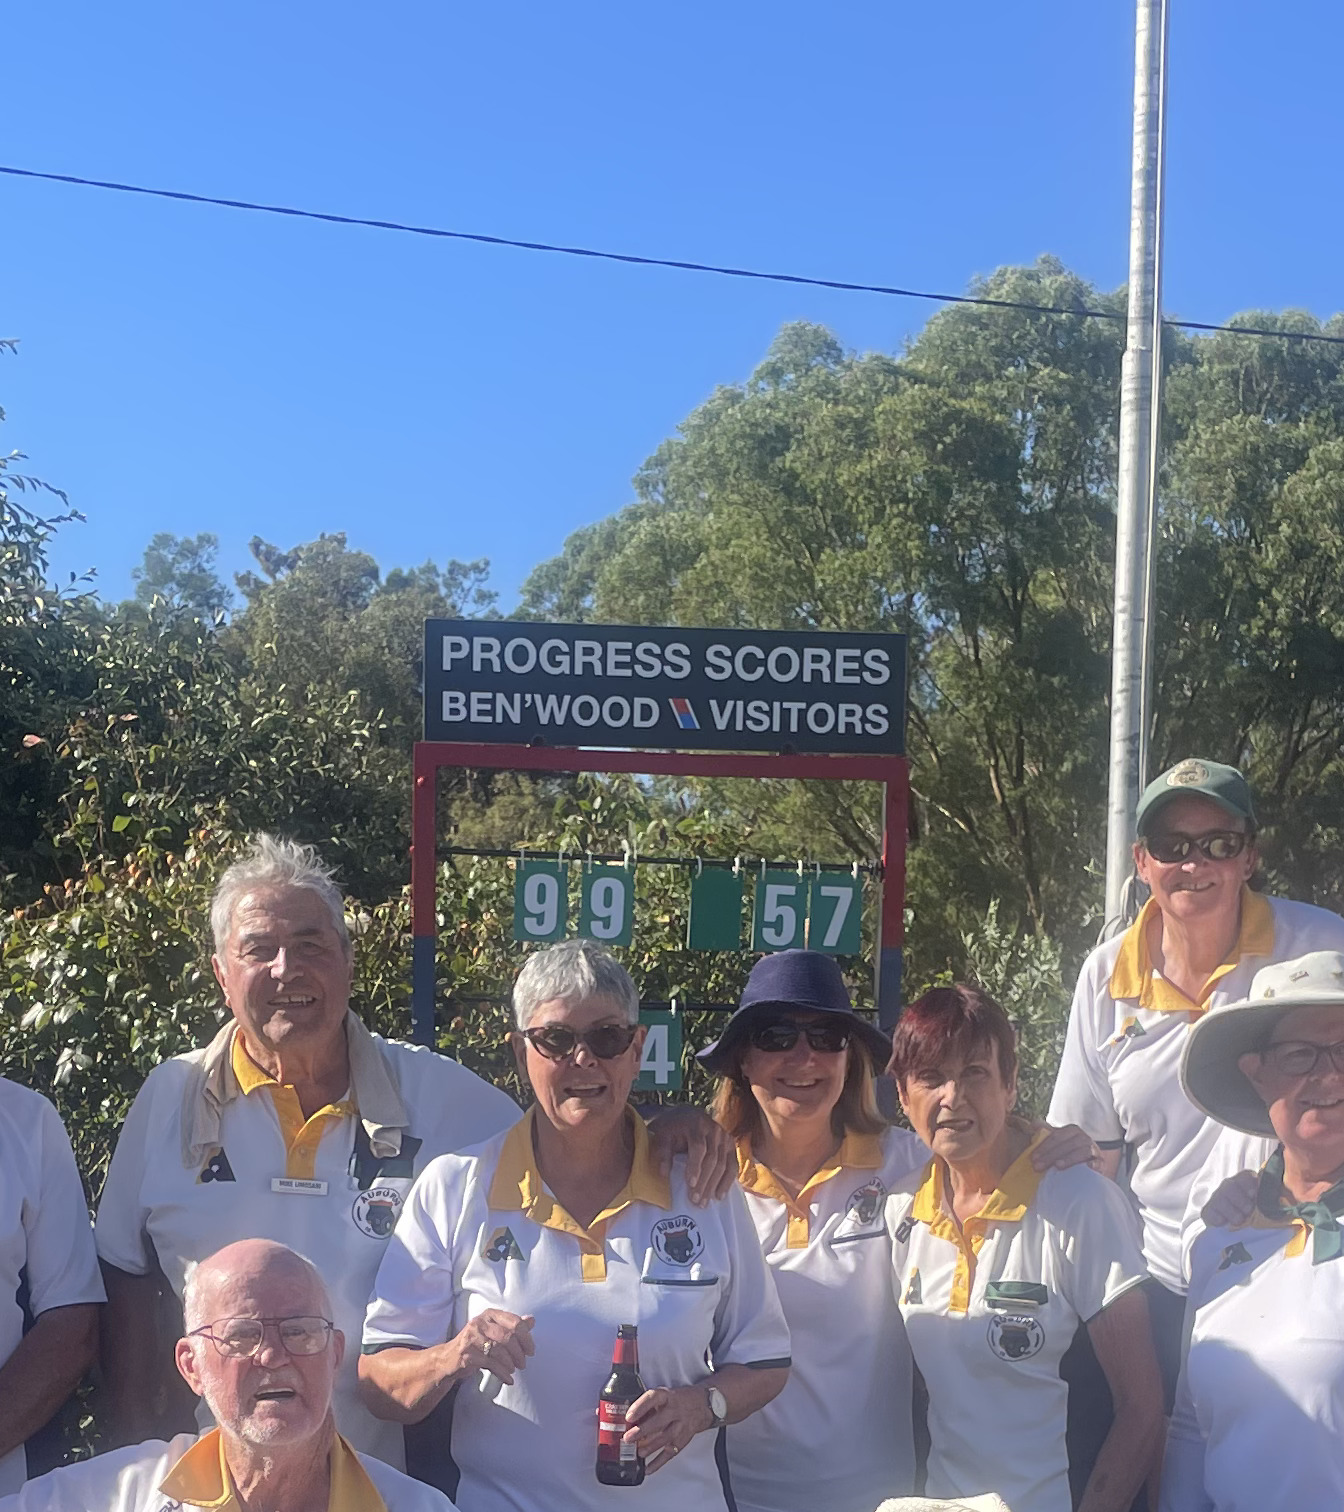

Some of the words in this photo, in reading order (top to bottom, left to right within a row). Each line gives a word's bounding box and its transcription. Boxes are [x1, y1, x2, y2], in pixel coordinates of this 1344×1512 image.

[441, 635, 691, 680] PROGRESS
[704, 643, 891, 686] SCORES
[441, 691, 659, 729] BEN'WOOD
[708, 699, 890, 735] VISITORS
[640, 1024, 675, 1084] 4
[656, 1214, 697, 1234] AUBURN
